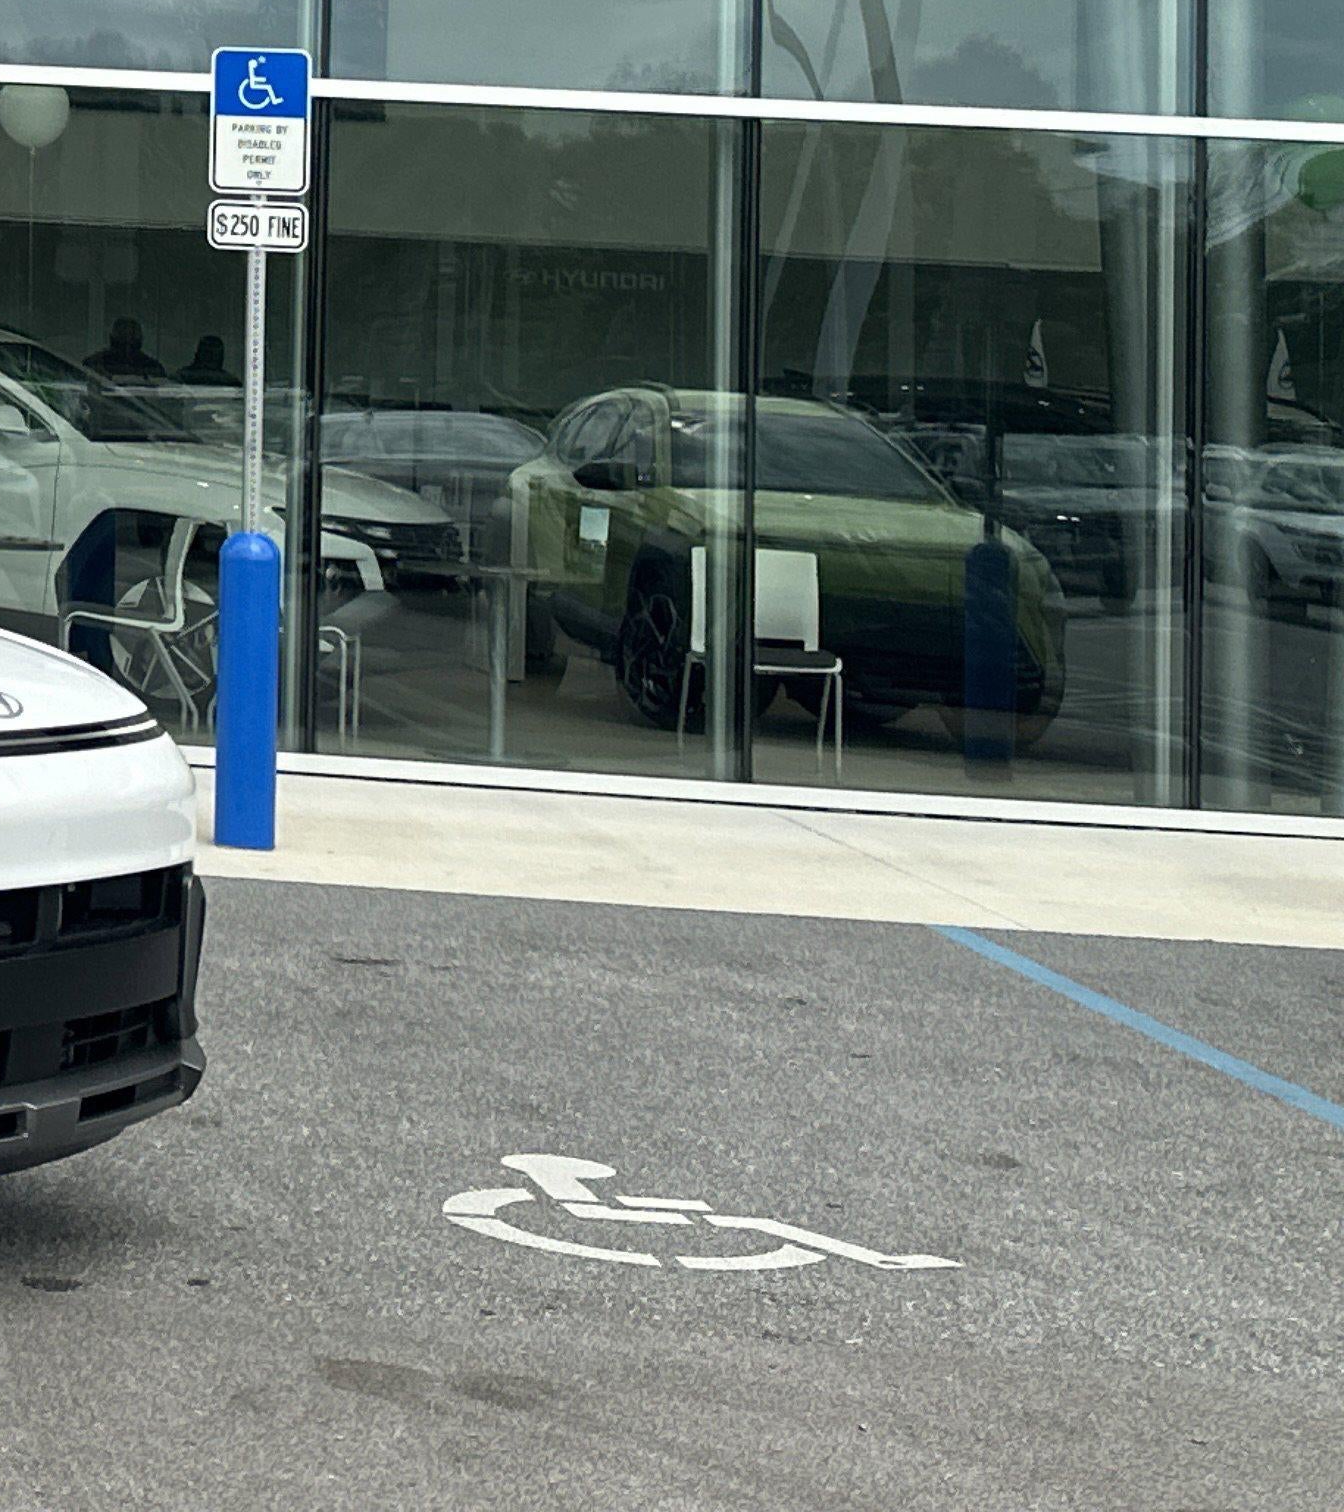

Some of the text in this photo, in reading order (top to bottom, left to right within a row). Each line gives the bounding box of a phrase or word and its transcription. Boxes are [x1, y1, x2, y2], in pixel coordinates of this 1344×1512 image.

[231, 123, 289, 135] PARKING BY
[242, 154, 277, 165] PERMIT
[247, 169, 273, 180] ONLY
[215, 212, 301, 239] $250 FINE
[541, 268, 666, 291] HYUNDAI
